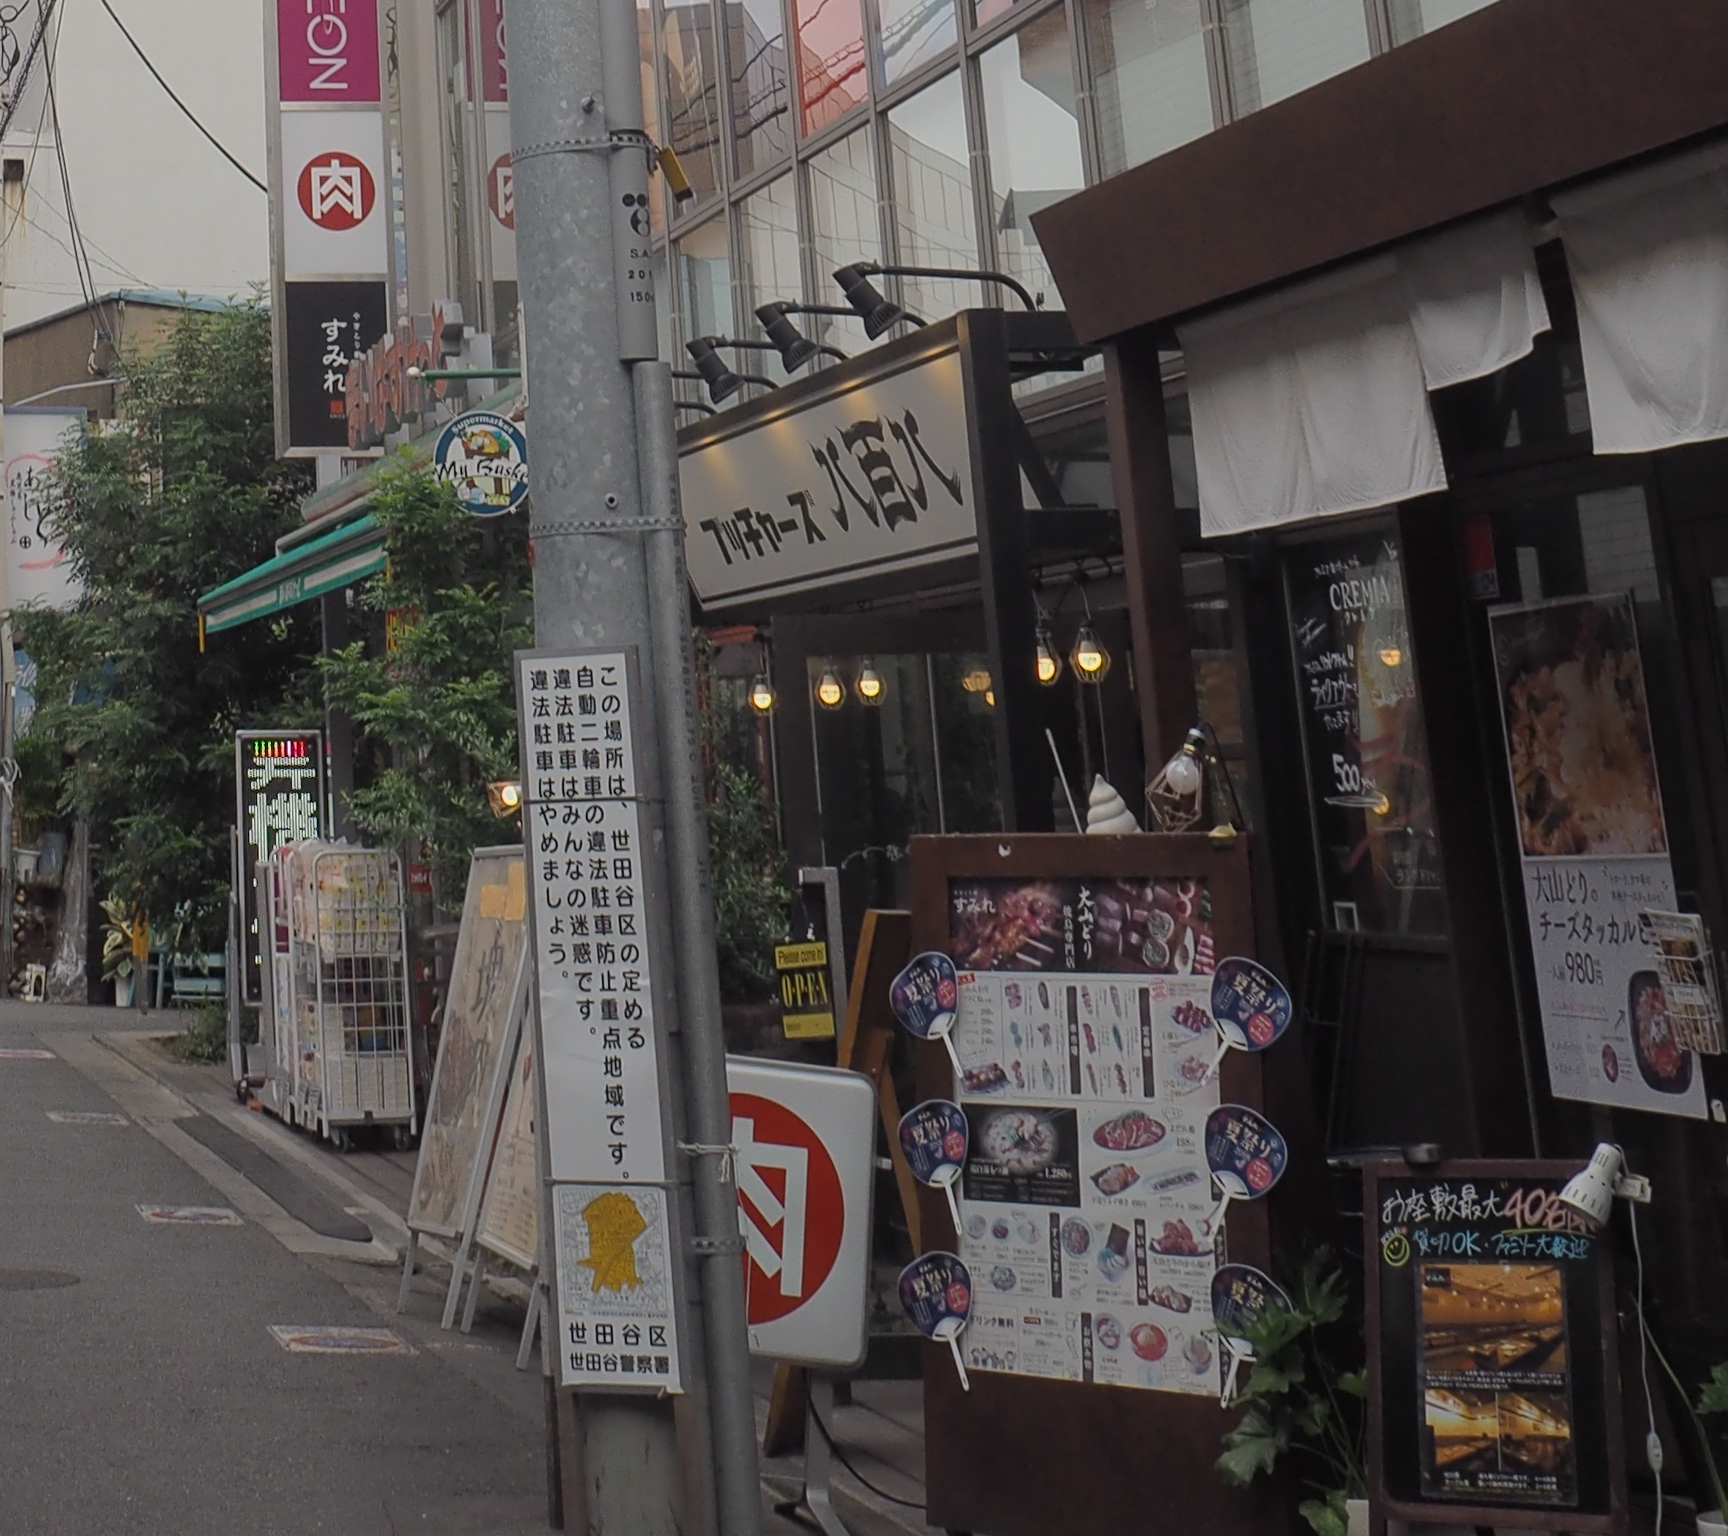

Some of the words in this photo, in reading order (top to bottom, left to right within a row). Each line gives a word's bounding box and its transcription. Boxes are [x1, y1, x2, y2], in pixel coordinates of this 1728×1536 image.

[310, 158, 363, 220] 肉
[321, 318, 349, 394] すみれ
[1329, 575, 1391, 612] CREMIA
[529, 669, 570, 979] 違法駐車はやめましょう。
[552, 668, 597, 1035] 違法駐車はみんなの迷惑です。
[600, 666, 646, 1050] この場所は、世田谷区の定める
[576, 665, 630, 1179] 自動二輪車の違法駐車防止重点地域です。
[953, 897, 997, 915] すみれ
[1077, 885, 1096, 961] 大山どり
[568, 1321, 667, 1347] 世田谷区
[569, 1351, 670, 1375] 世田谷警察署
